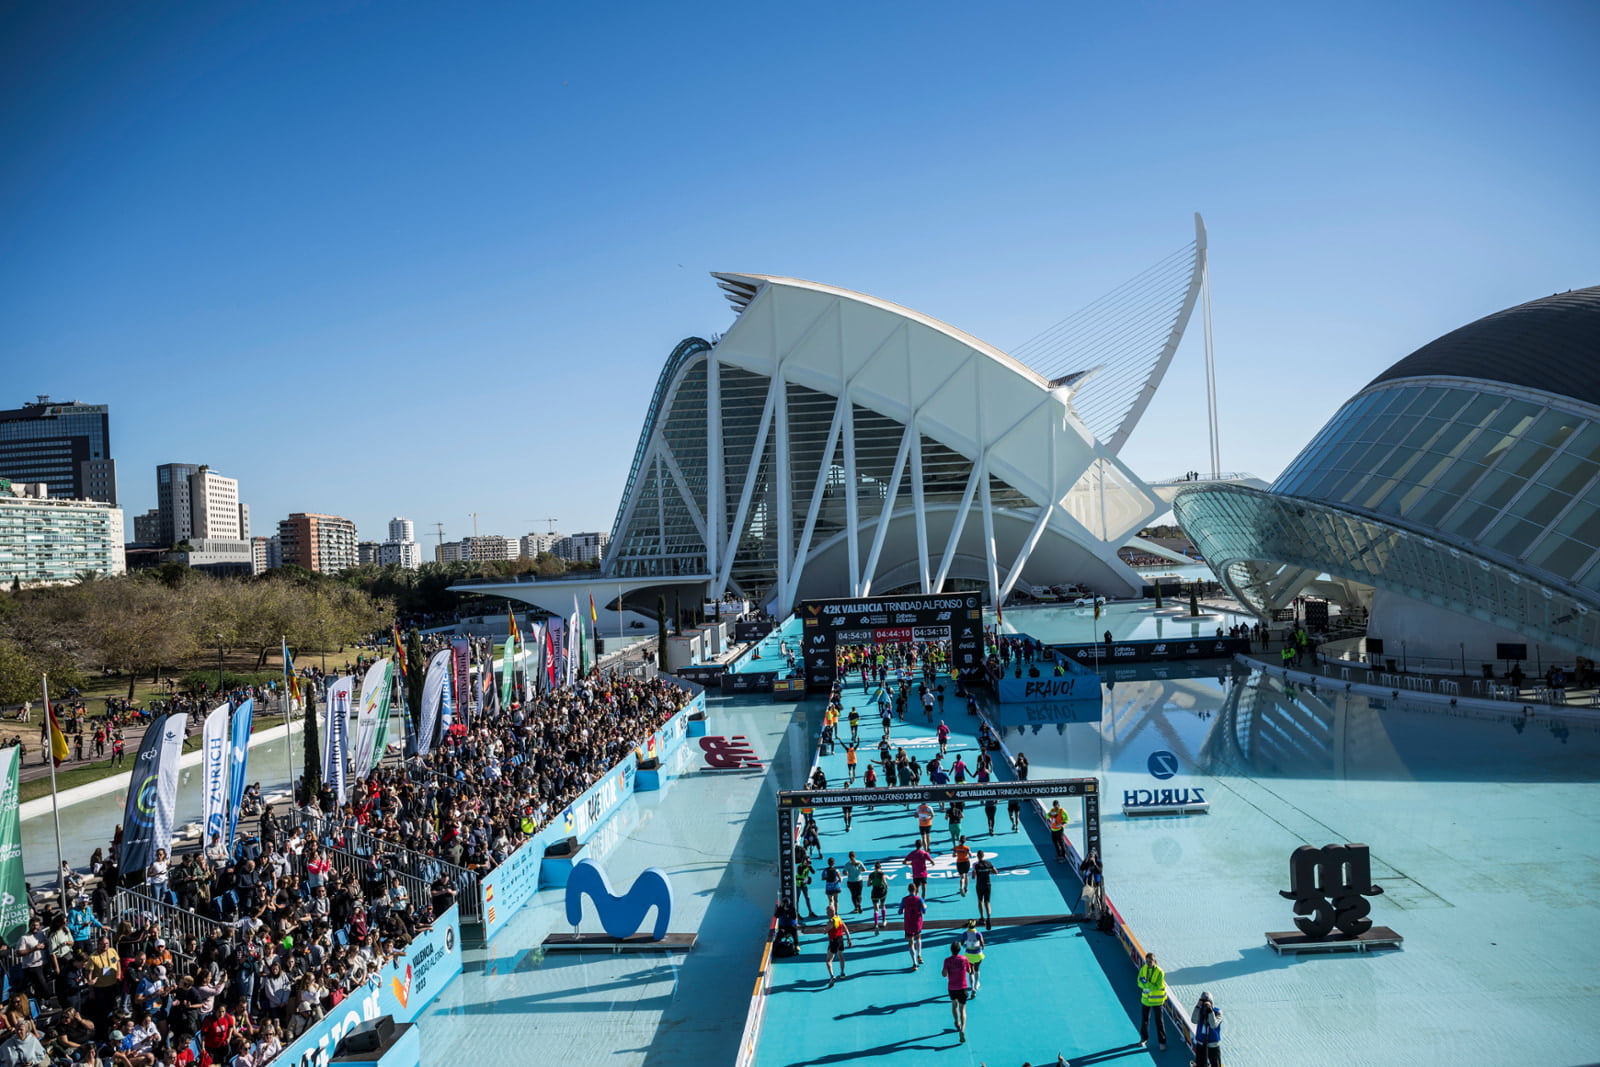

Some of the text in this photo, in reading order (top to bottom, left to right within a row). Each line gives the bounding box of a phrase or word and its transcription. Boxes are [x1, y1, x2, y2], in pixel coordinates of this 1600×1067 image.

[823, 599, 963, 614] 42K VALENCIA TRINIDAD ALFONSO
[1025, 679, 1075, 697] BRAVO!
[332, 711, 346, 735] Run
[329, 740, 343, 766] your
[210, 737, 222, 803] ZURICH
[969, 789, 996, 797] VALENCIA
[997, 788, 1023, 796] TRINIDAD
[412, 943, 433, 968] VALENCIA
